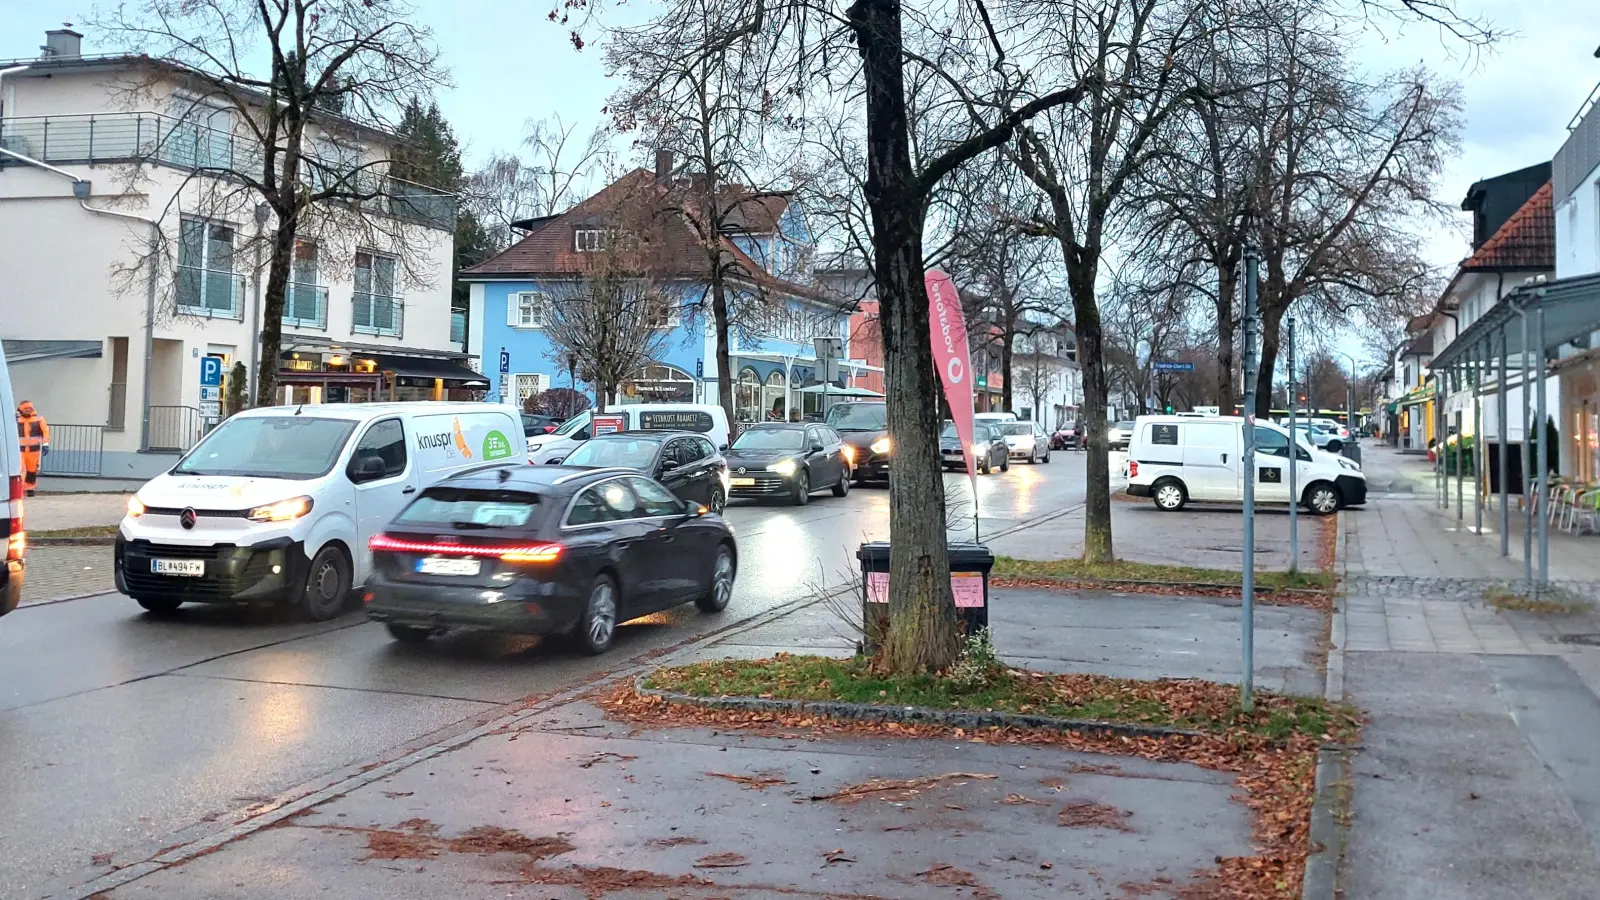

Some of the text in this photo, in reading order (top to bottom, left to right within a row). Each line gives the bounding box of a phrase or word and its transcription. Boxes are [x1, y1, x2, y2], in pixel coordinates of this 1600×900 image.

[205, 360, 216, 381] P
[416, 432, 451, 450] knuspr
[158, 562, 167, 571] BL
